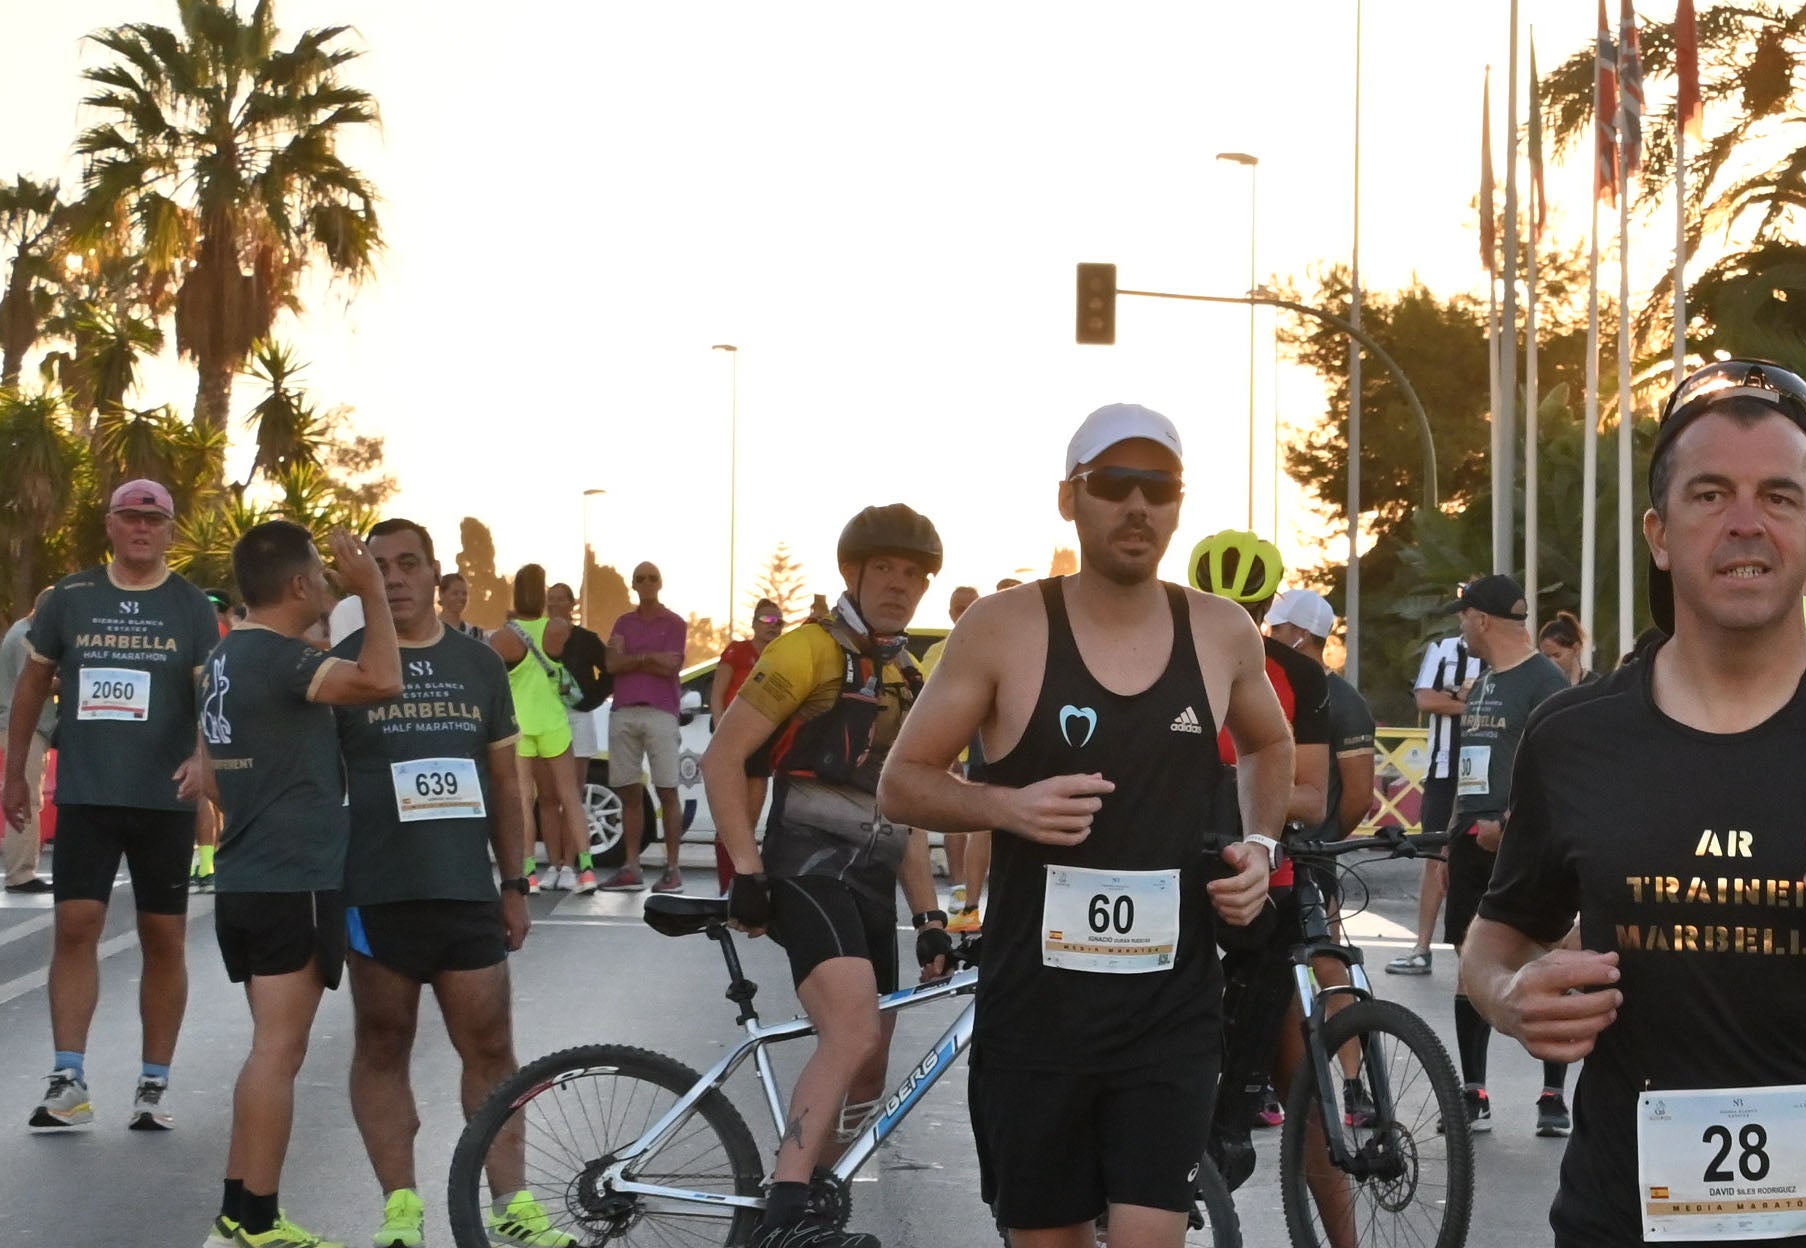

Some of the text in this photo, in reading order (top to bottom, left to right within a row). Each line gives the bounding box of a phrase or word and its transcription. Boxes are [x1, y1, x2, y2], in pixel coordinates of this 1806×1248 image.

[75, 634, 177, 652] MARBELLA
[83, 651, 167, 662] HALF MARATHON
[92, 681, 134, 700] 2060
[403, 690, 449, 699] ESTATES
[367, 702, 482, 724] MARBELLA
[383, 721, 477, 734] HALF MARATHON
[1170, 723, 1202, 734] adidas
[415, 772, 458, 796] 639
[1695, 829, 1753, 857] AR
[1088, 893, 1134, 934] 60
[885, 1049, 939, 1117] BERG
[1702, 1124, 1770, 1183] 28
[1709, 1187, 1735, 1196] DAVID
[1672, 1204, 1723, 1212] MEDIA
